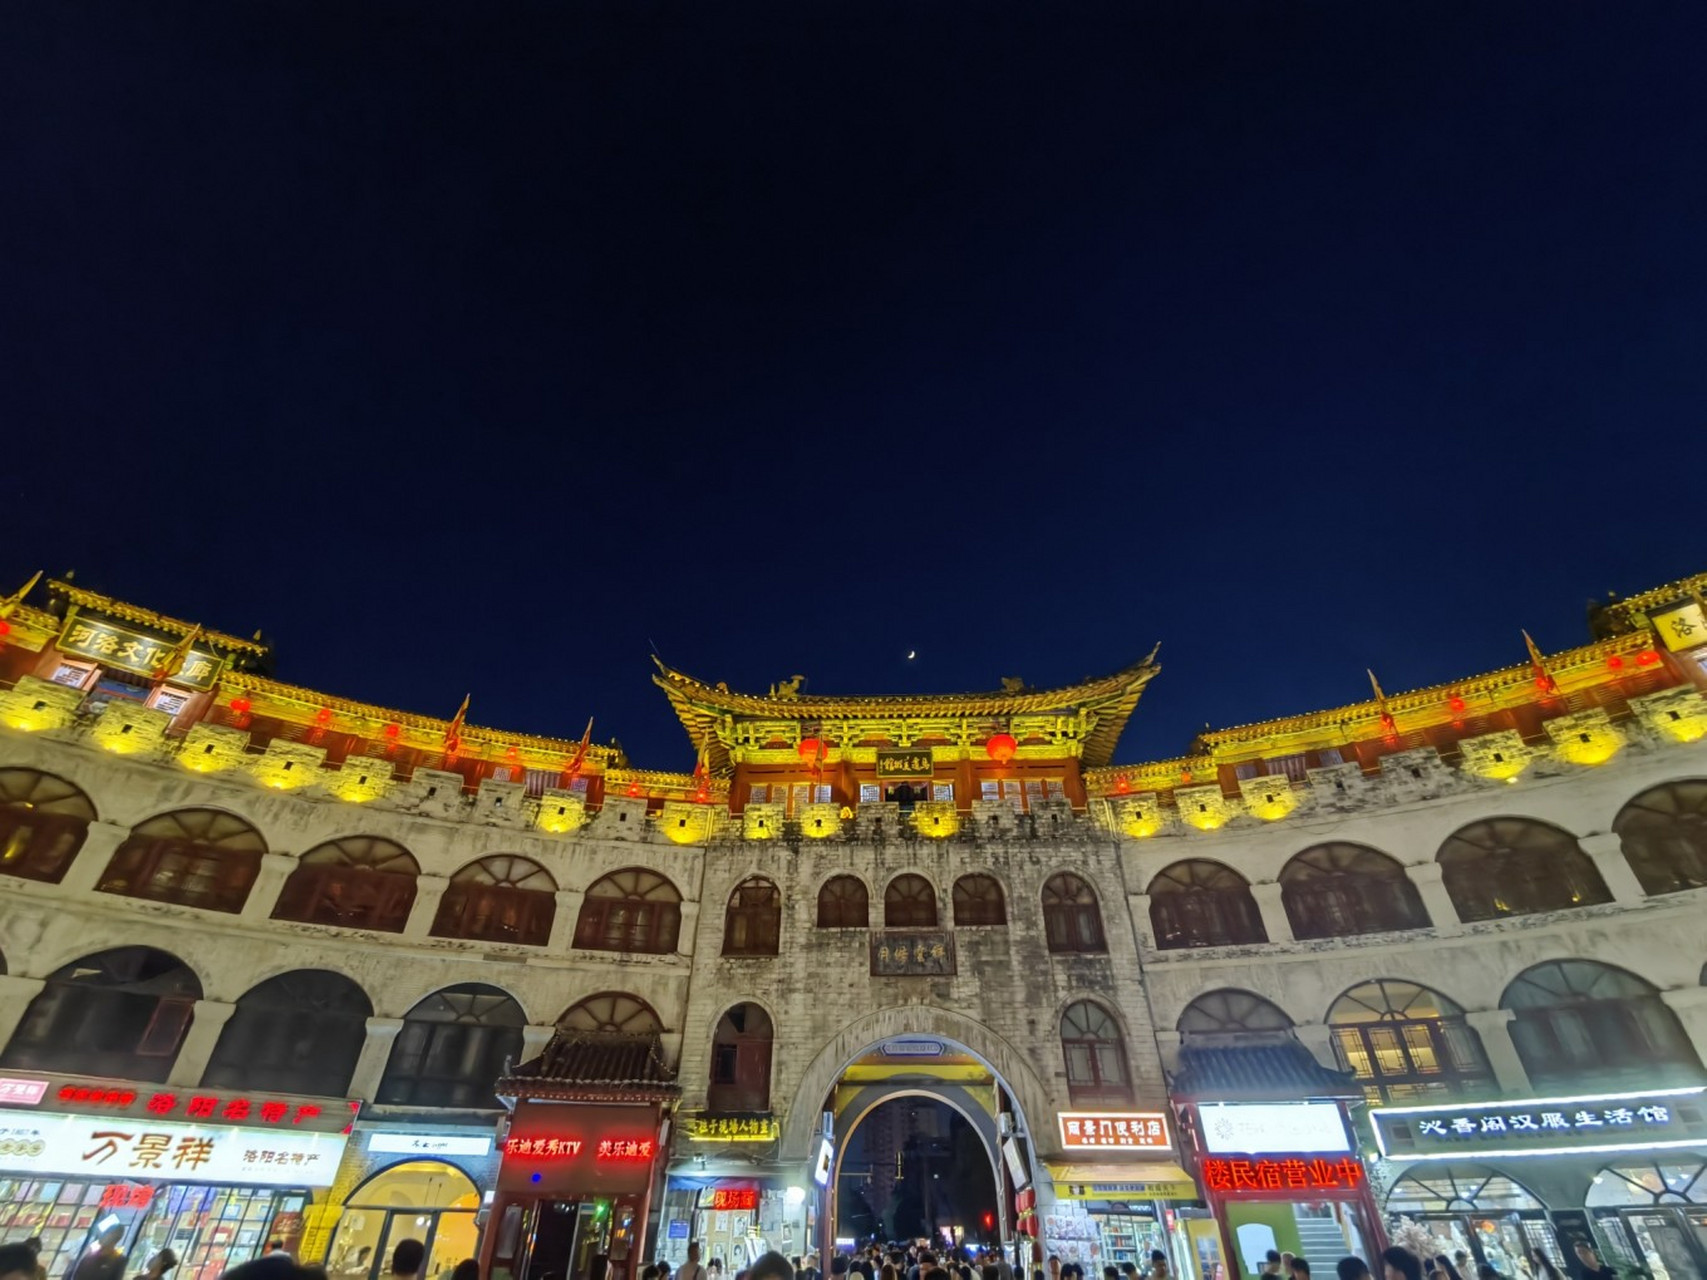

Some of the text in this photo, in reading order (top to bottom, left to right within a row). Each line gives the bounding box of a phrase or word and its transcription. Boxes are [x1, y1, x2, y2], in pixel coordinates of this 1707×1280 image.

[68, 625, 213, 681] 河洛文化廊
[147, 1093, 322, 1125] 洛阳名特产
[1419, 1105, 1669, 1136] 沁香阁汉服生活馆
[82, 1130, 215, 1172] 万景祥
[242, 1149, 321, 1166] 洛阳名特产
[1204, 1158, 1363, 1190] 楼民宿营业中
